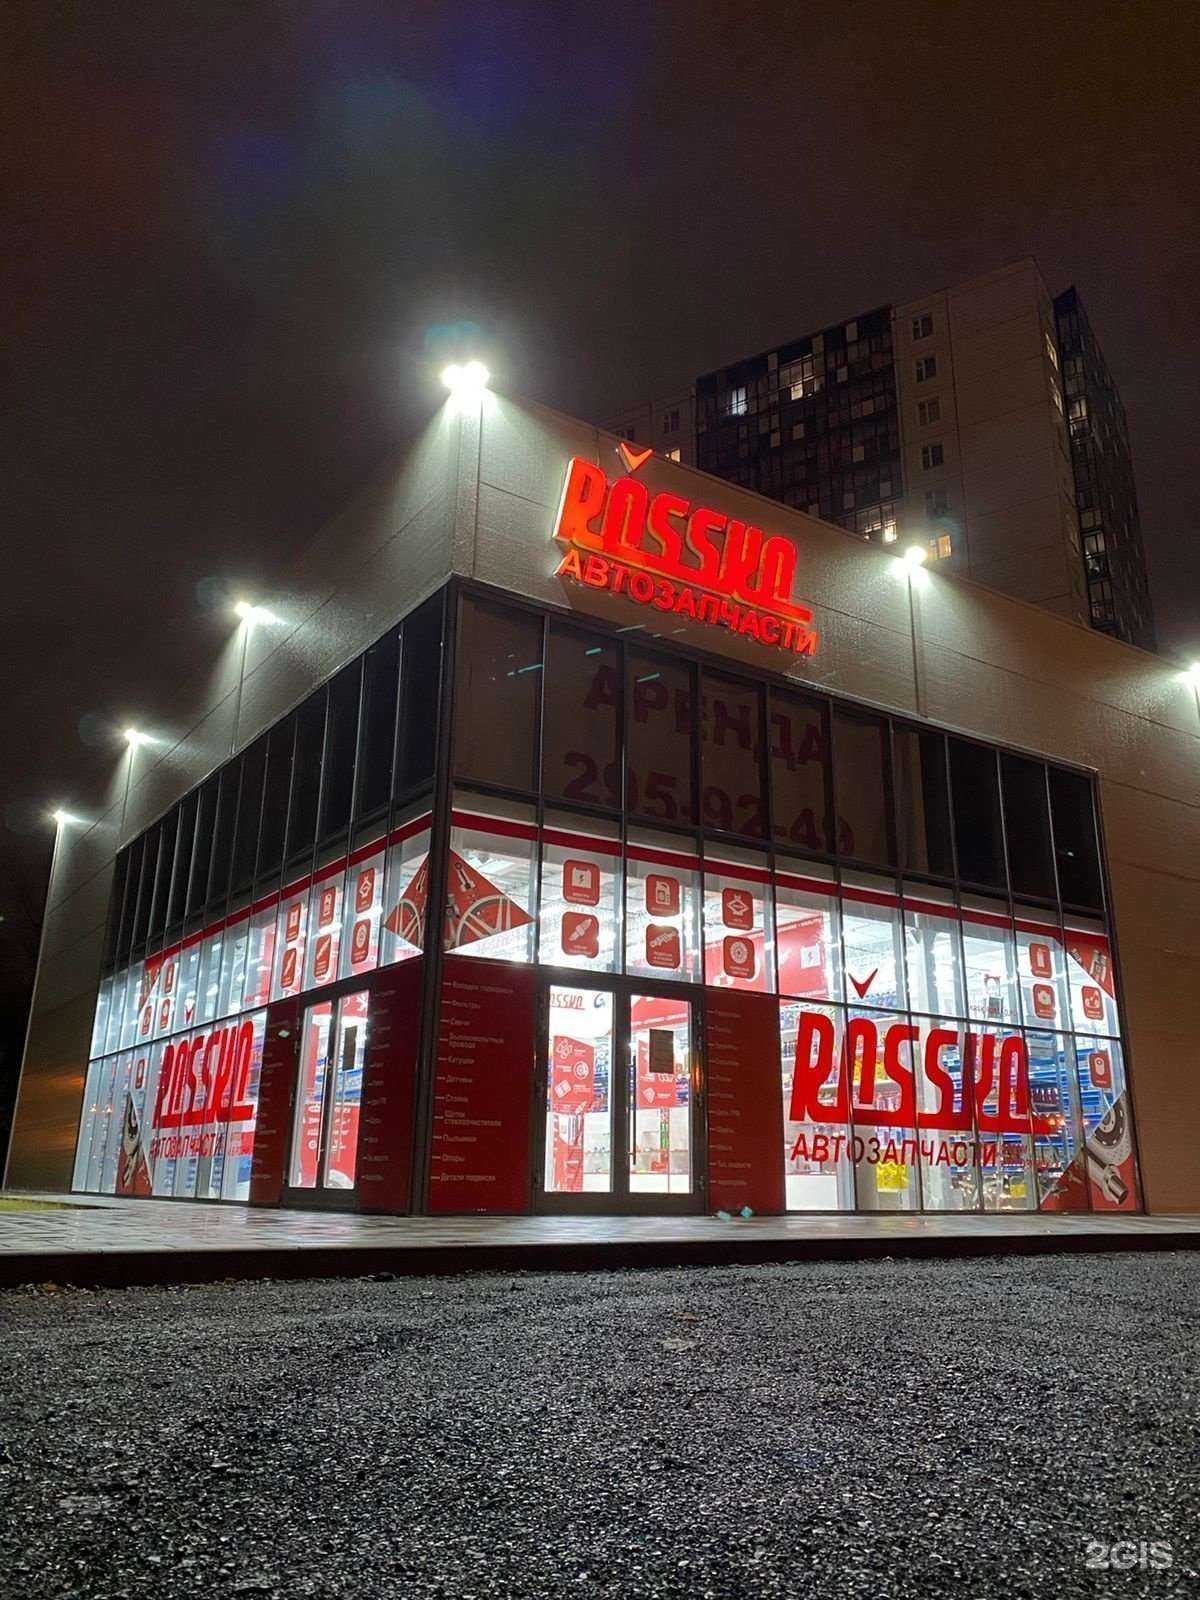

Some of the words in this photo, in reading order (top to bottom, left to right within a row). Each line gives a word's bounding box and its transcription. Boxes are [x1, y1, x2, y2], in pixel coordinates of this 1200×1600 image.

[552, 456, 813, 625] ROSSKO
[555, 547, 819, 657] АВТОЗАПЧАСТИ
[582, 664, 827, 771] АРЕНДА
[790, 1011, 1054, 1135] ROSSKO
[148, 1132, 225, 1159] АВТОЗАПЧАСТИ
[790, 1133, 997, 1167] АВТОЗАПЧАСТИ
